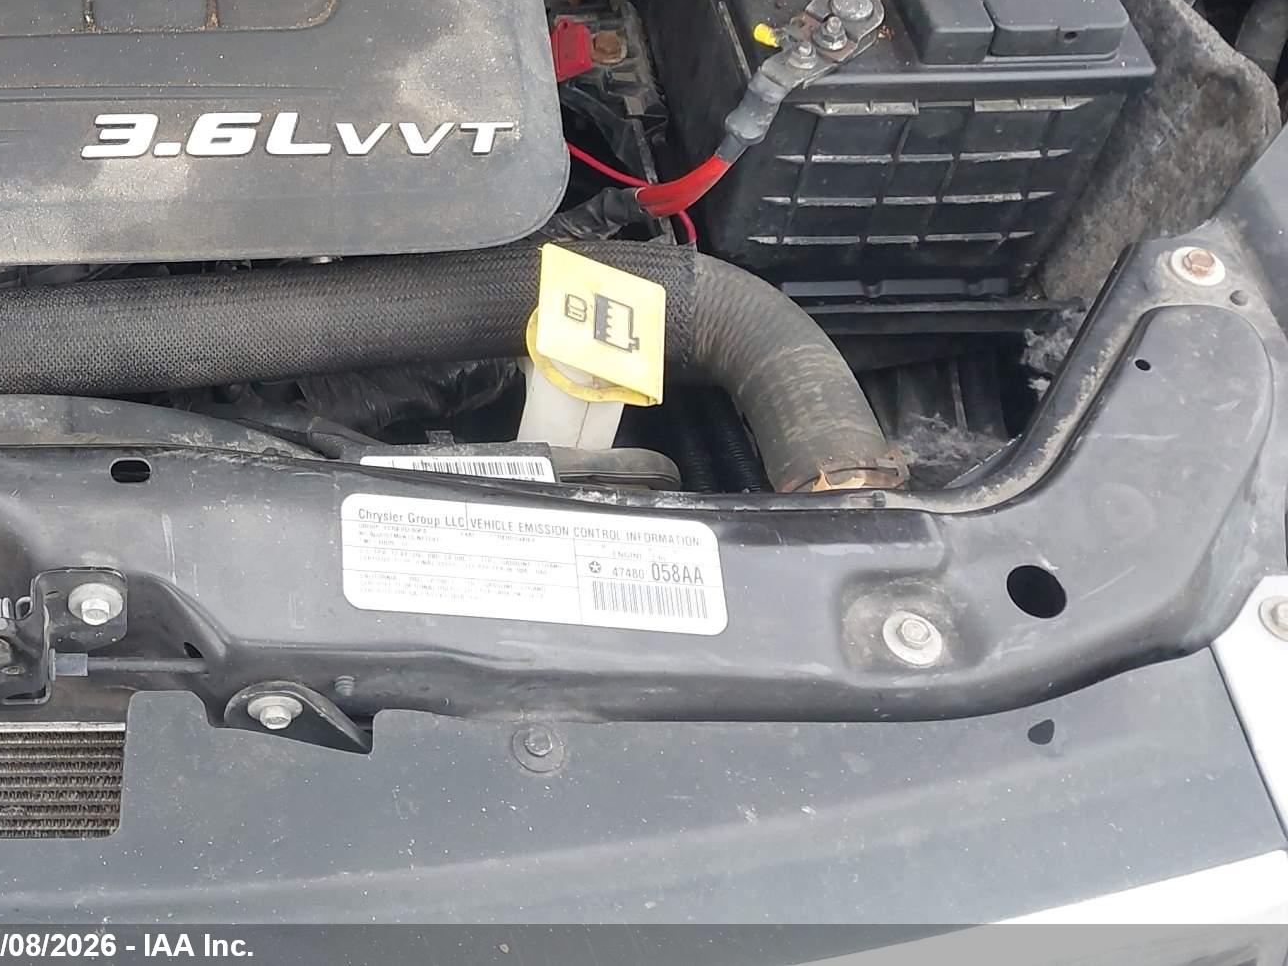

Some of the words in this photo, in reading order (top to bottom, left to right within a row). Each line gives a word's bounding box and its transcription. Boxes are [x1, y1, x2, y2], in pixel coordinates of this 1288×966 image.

[358, 508, 404, 523] Chrysler
[408, 512, 441, 528] Group
[445, 516, 465, 528] LLC
[470, 519, 513, 532] VEHICLE
[519, 522, 569, 536] EMISSION
[573, 527, 622, 541] CONTROL
[626, 532, 699, 547] INFORMATION
[651, 562, 704, 584] 058AA
